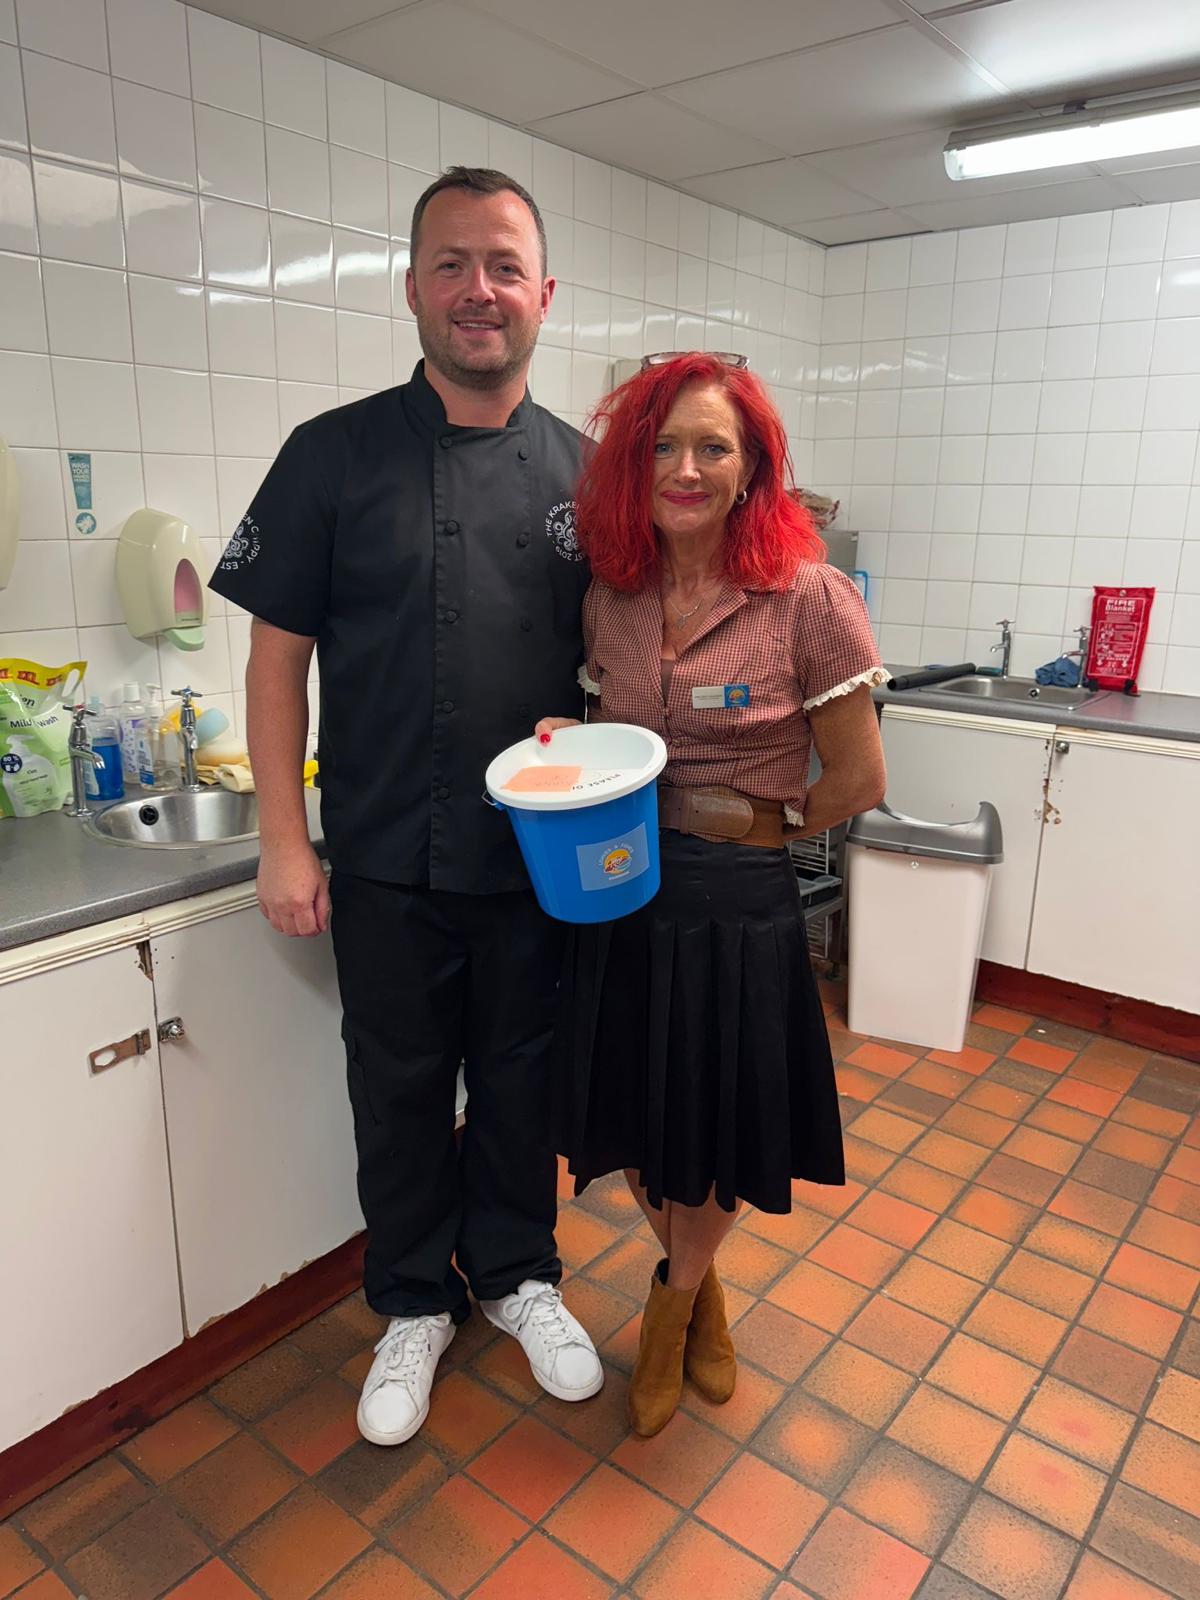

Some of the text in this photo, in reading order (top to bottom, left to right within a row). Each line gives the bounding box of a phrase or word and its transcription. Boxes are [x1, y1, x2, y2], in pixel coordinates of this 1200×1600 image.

[545, 500, 577, 537] THE KRAKE
[220, 561, 239, 570] EST
[1106, 599, 1136, 607] FIRE
[1105, 604, 1135, 613] Blanket
